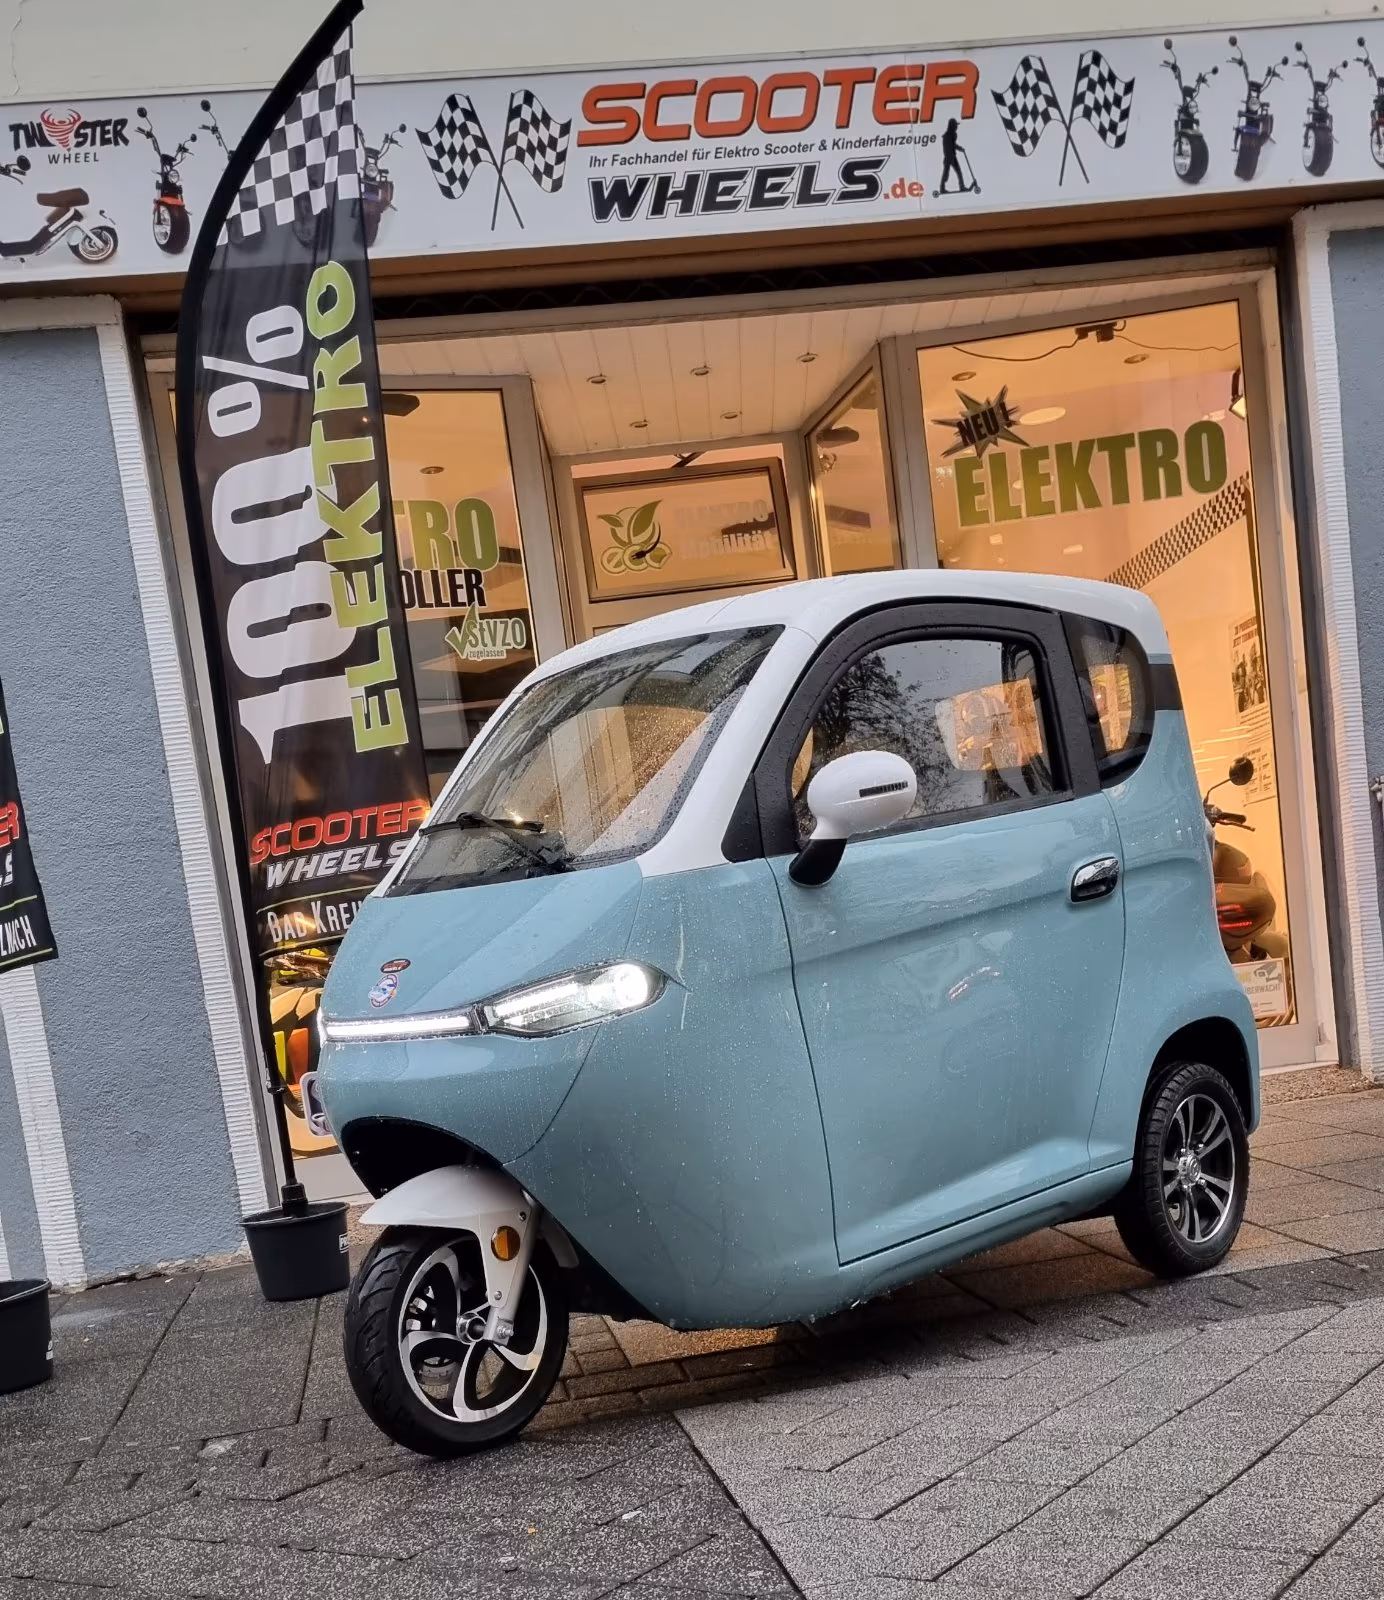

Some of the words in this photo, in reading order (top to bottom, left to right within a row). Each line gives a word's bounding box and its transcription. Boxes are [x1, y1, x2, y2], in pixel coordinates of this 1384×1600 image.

[577, 60, 980, 148] SCOOTER
[48, 152, 99, 165] WHEEL
[589, 155, 608, 168] Ihr
[611, 150, 689, 167] Fachhandel
[692, 148, 711, 161] für
[714, 145, 760, 160] Elektro
[764, 139, 815, 156] Scooter
[818, 139, 828, 152] &
[832, 133, 937, 151] Kinderfahrzeuge
[588, 155, 891, 223] WHEELS
[306, 260, 409, 753] ELEKTRO
[954, 420, 1228, 528] ELEKTRO
[466, 618, 526, 649] StVZO
